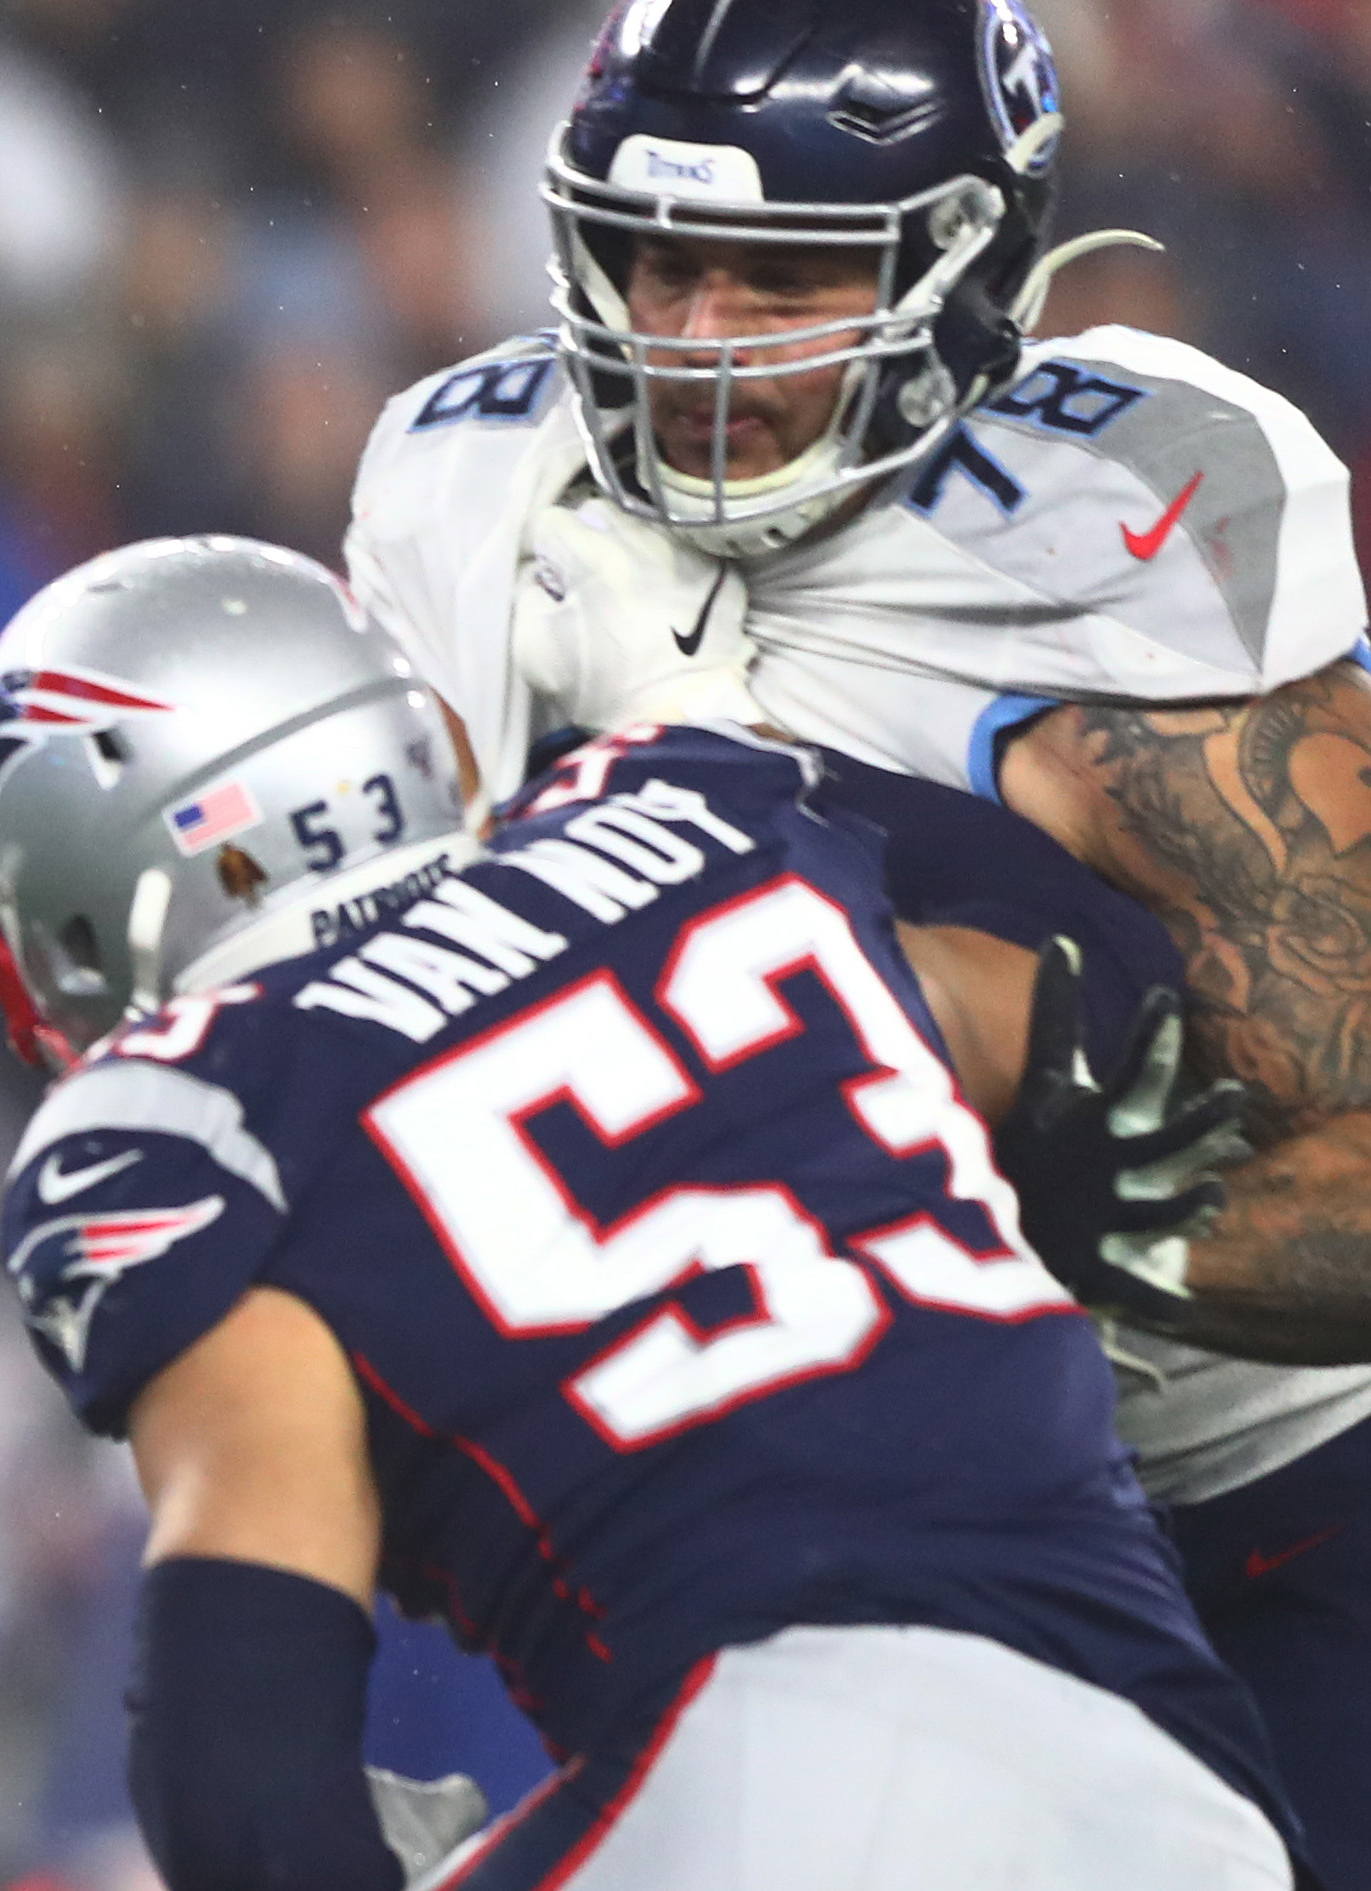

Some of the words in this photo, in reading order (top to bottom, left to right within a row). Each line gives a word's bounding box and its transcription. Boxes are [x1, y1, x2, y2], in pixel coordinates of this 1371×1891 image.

[289, 775, 405, 871] 53
[293, 876, 568, 1043] VAN
[359, 872, 1088, 1454] 53
